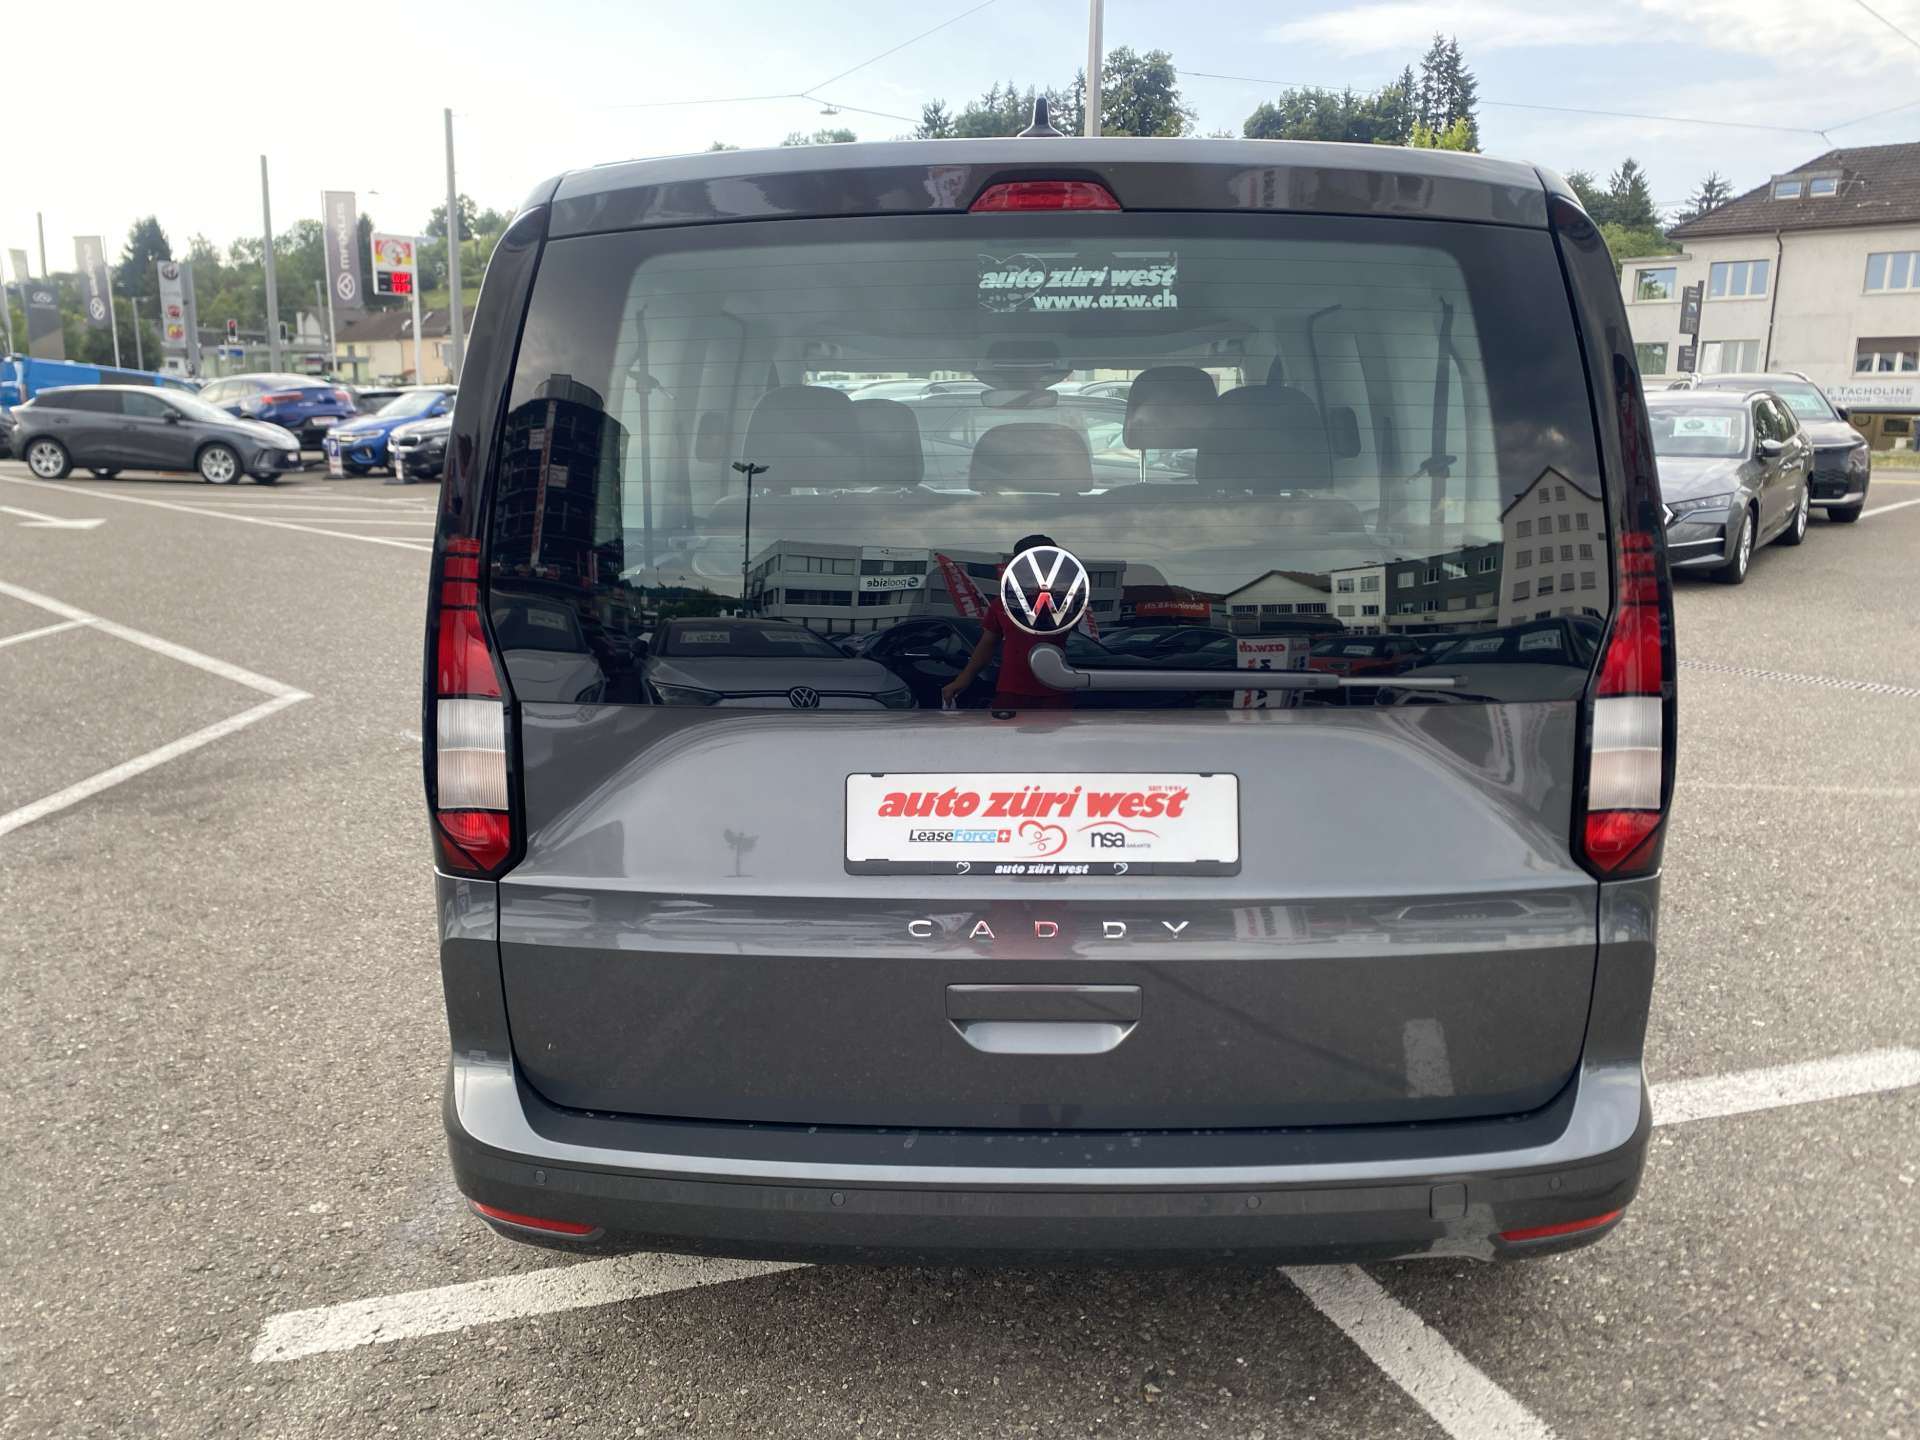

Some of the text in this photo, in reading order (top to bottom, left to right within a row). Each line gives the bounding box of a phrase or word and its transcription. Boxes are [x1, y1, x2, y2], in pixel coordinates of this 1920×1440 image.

[978, 265, 1177, 289] auto züri west
[1032, 288, 1178, 310] www.azw.ch
[877, 785, 1191, 818] auto züri west
[908, 828, 997, 843] LeaseForce
[1090, 830, 1126, 849] nsa
[994, 863, 1089, 874] auto züri west
[907, 920, 1191, 939] CADDY
